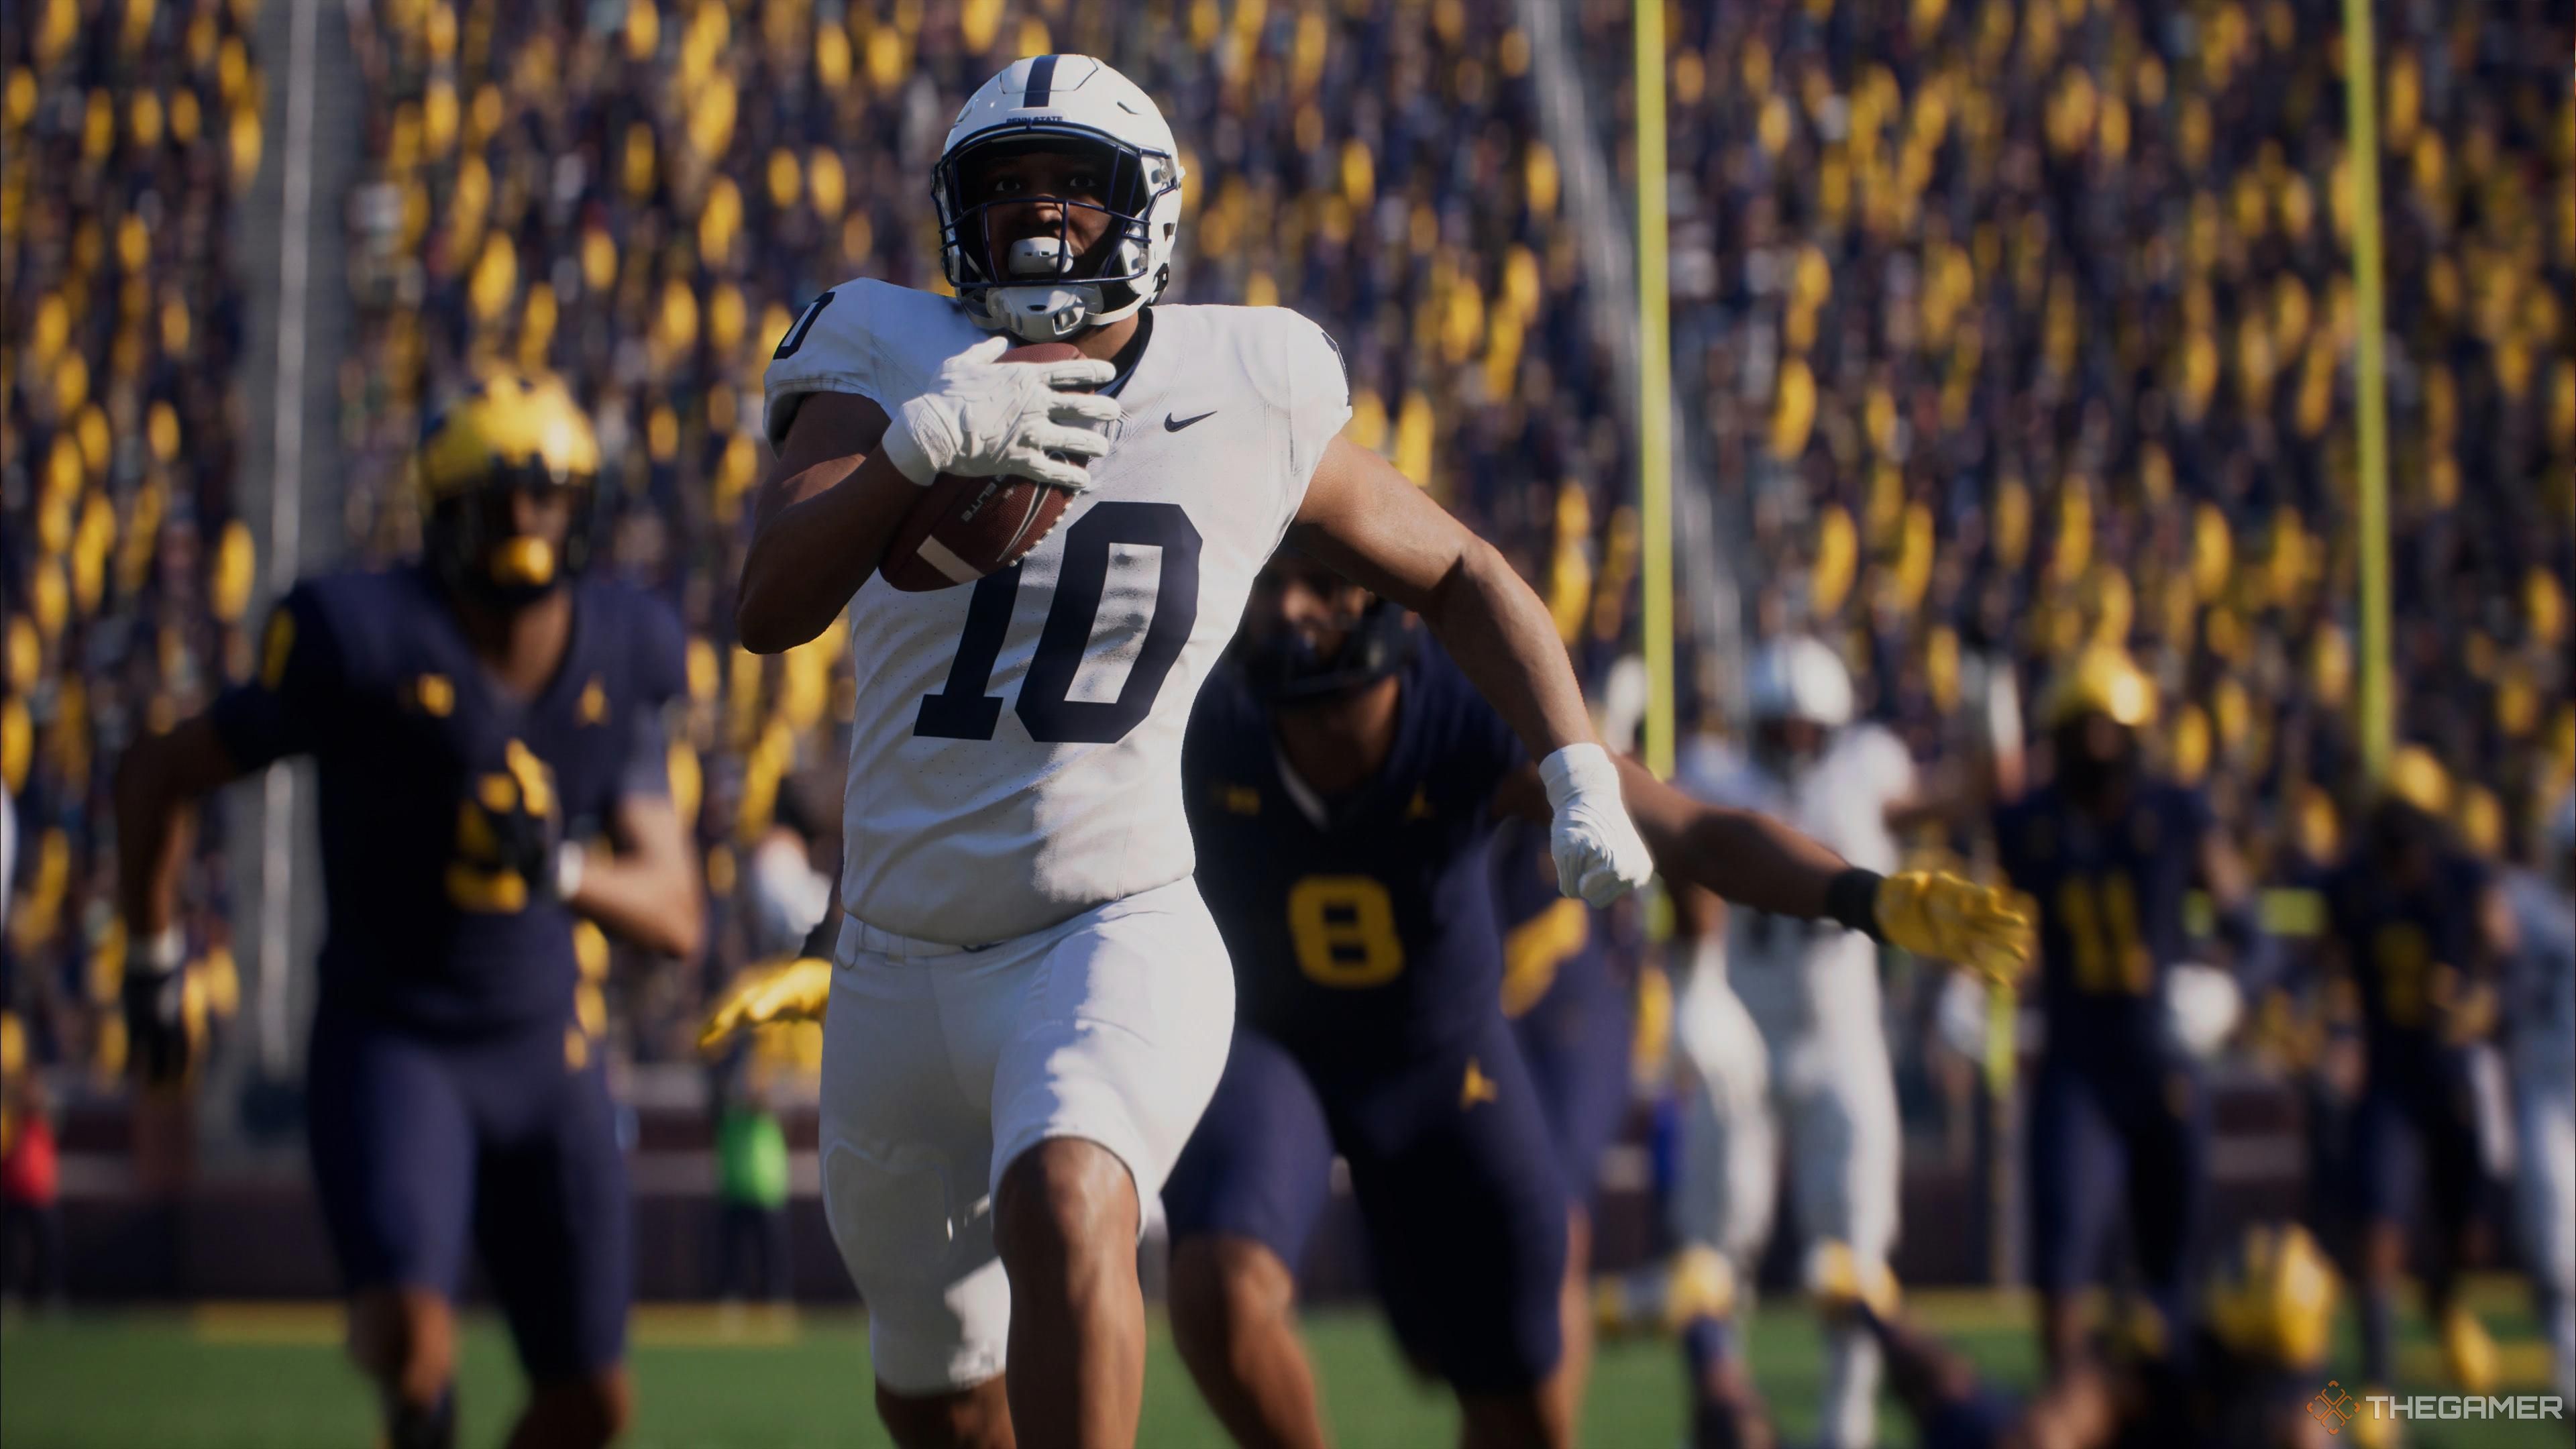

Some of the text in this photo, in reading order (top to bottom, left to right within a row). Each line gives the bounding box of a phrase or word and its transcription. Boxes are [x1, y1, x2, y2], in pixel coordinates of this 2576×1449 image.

[961, 482, 997, 522] ELITE
[913, 501, 1203, 743] 10
[1287, 874, 1406, 989] 8
